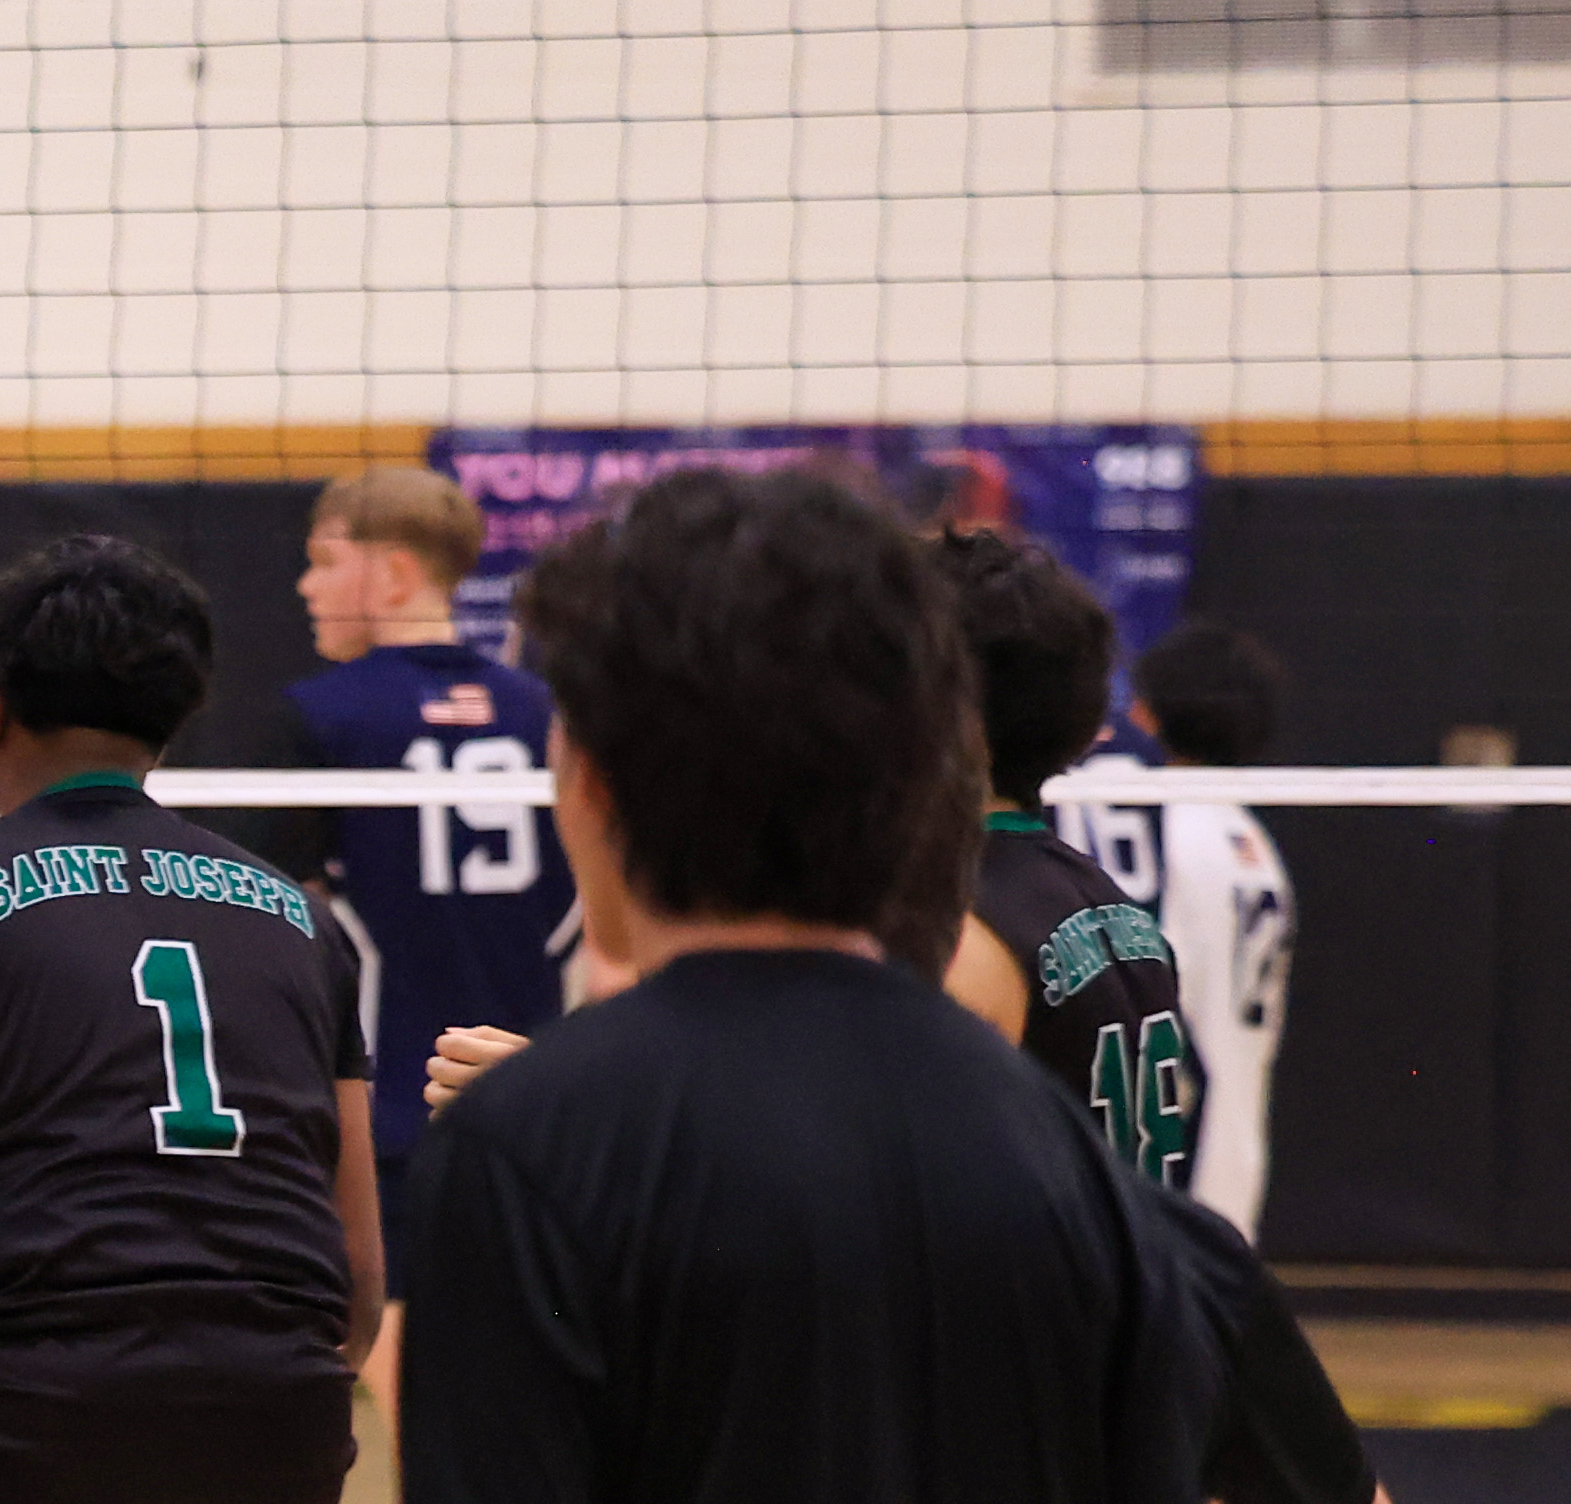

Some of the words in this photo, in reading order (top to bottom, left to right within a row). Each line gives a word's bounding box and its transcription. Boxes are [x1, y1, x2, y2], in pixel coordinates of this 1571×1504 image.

[455, 452, 584, 500] YOU
[401, 737, 540, 895] 19
[140, 848, 316, 939] JOSEPH
[131, 938, 247, 1158] 1
